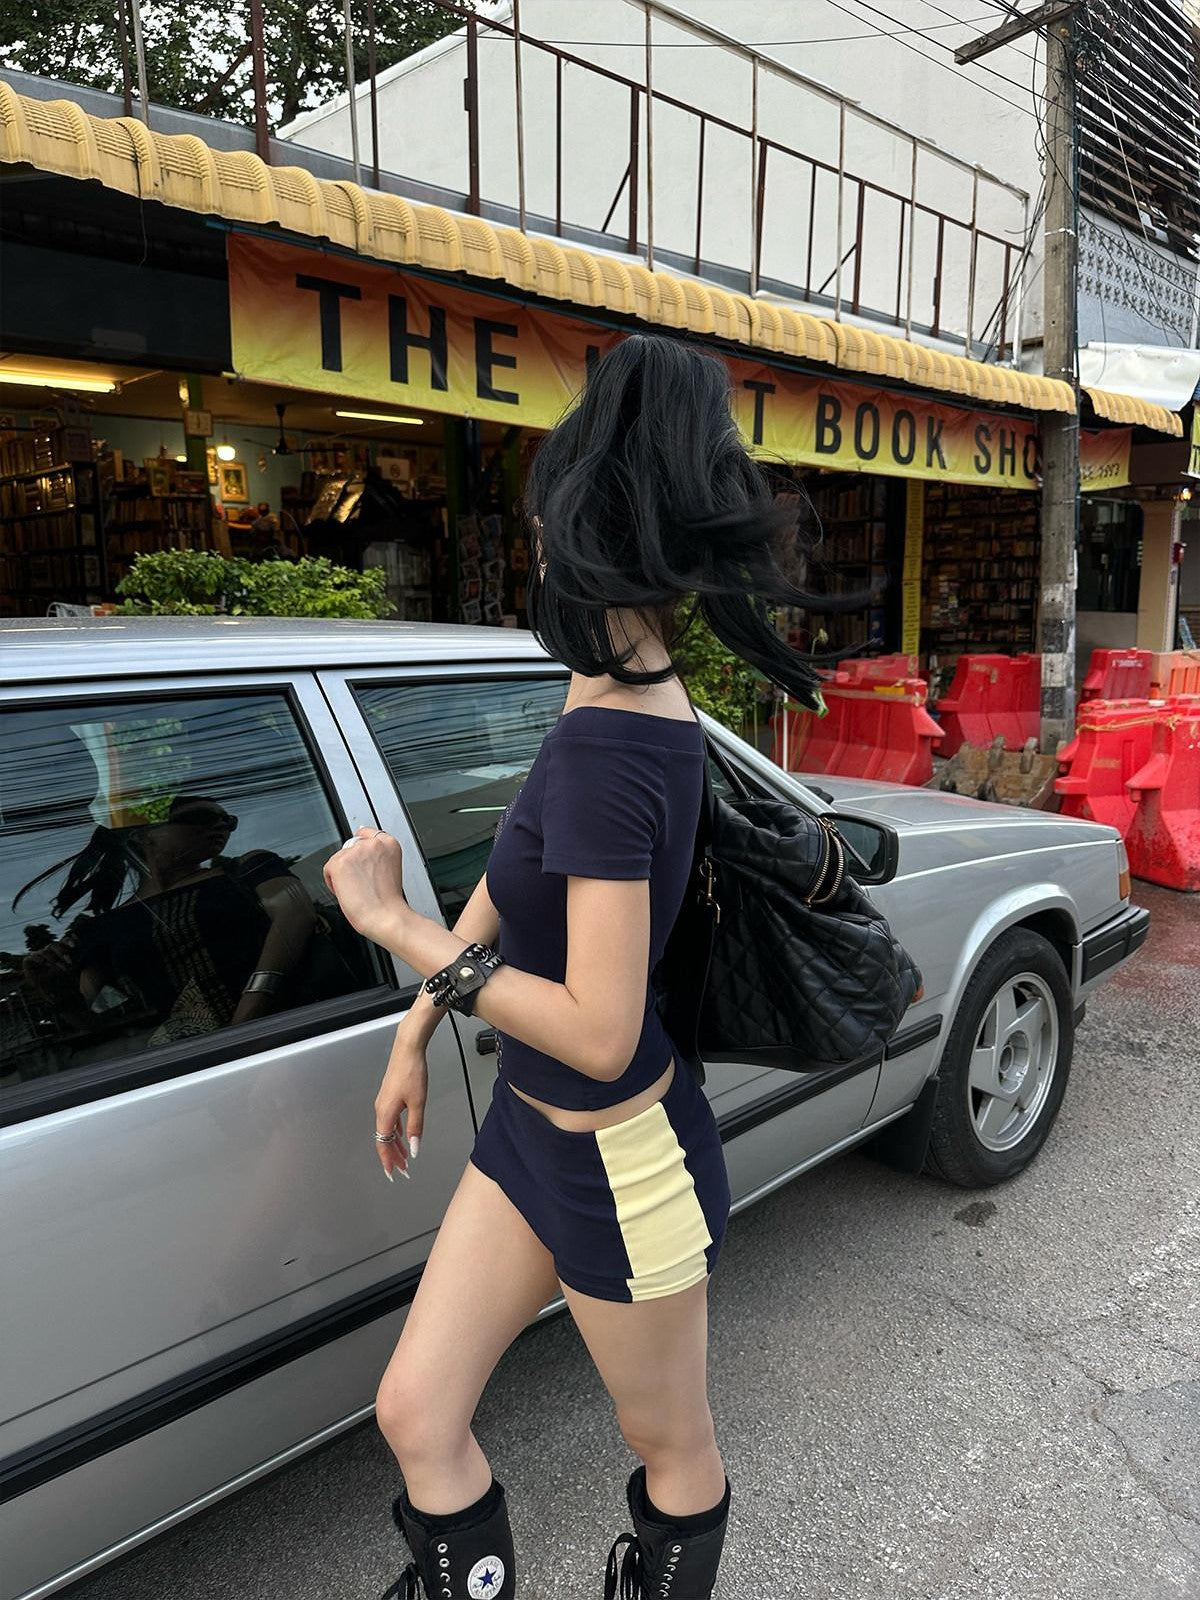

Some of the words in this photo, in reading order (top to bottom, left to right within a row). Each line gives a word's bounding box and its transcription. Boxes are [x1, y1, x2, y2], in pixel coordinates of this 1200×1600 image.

[296, 273, 519, 405] THE
[815, 394, 947, 470] BOOK
[974, 424, 1039, 480] SHO
